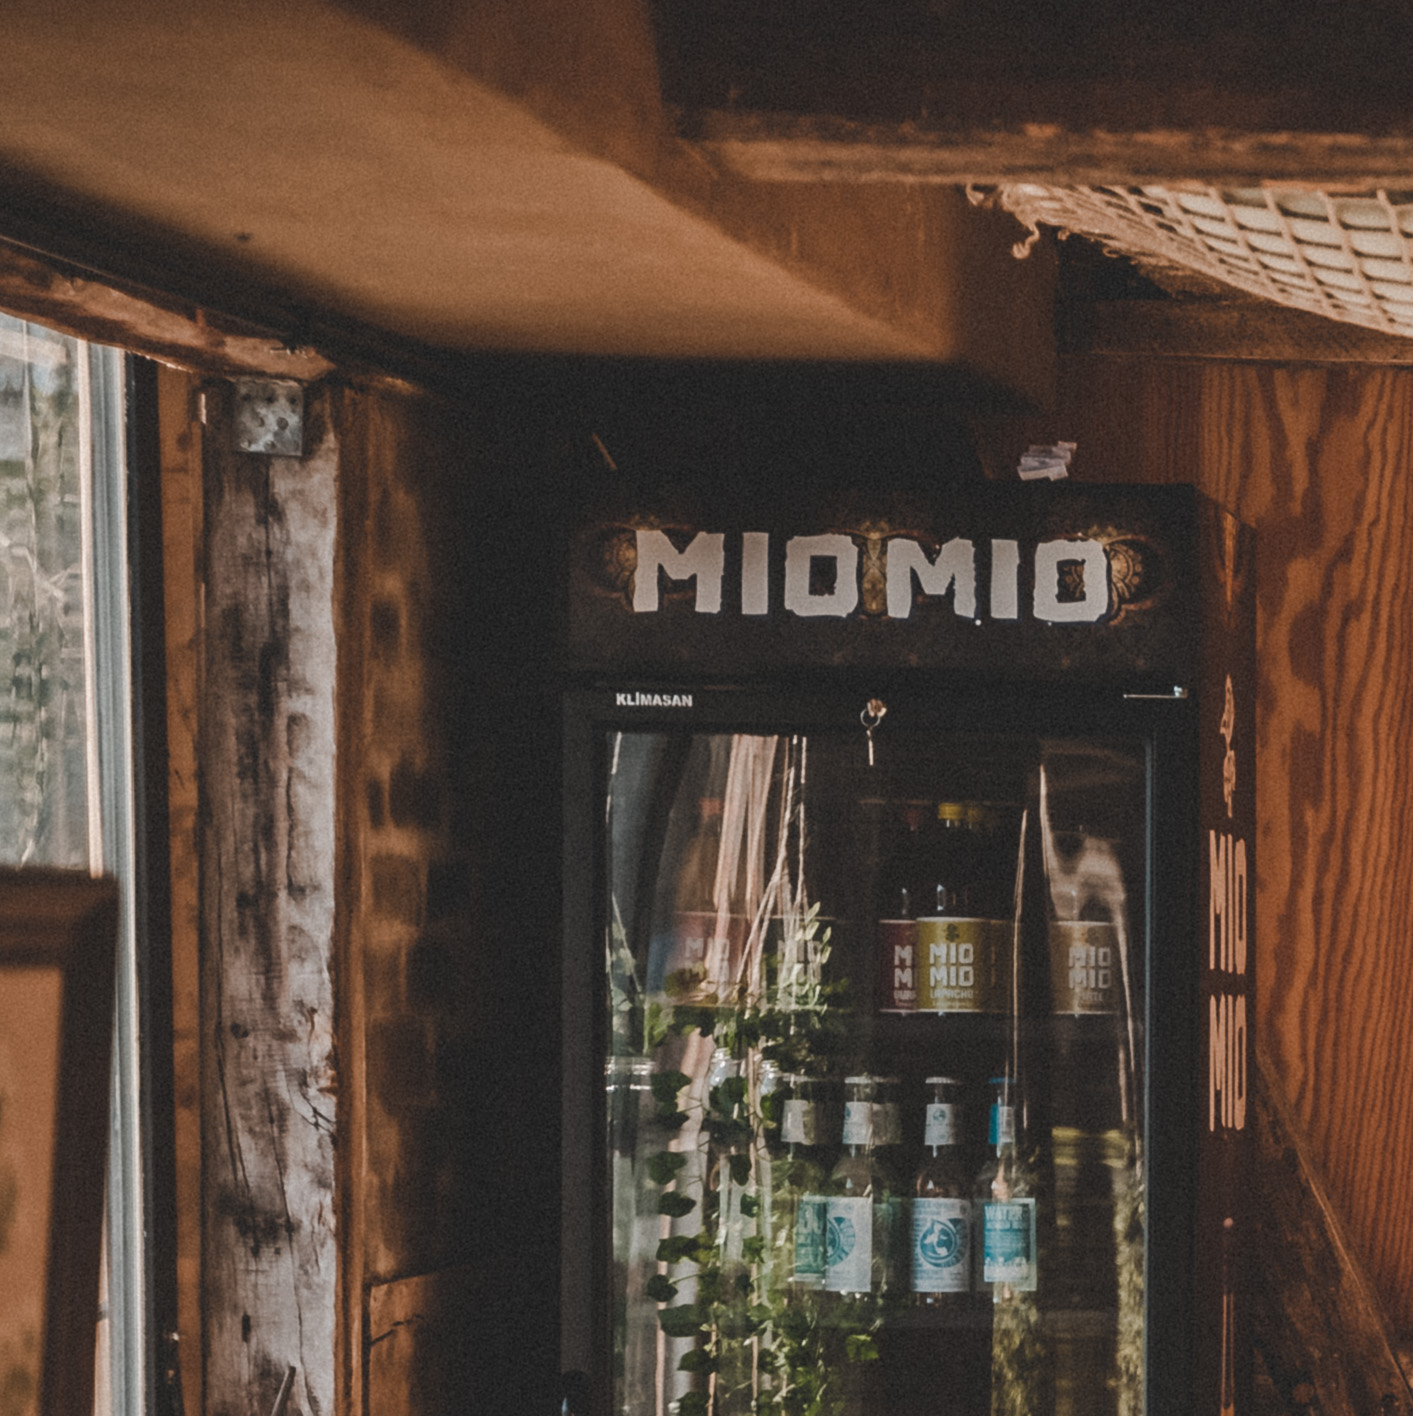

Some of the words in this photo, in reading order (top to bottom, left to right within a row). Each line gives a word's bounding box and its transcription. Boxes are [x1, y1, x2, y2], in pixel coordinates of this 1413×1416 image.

[929, 942, 974, 965] MIO
[1069, 946, 1112, 967] MIO
[929, 965, 974, 987] MIO
[1069, 968, 1112, 989] MIO
